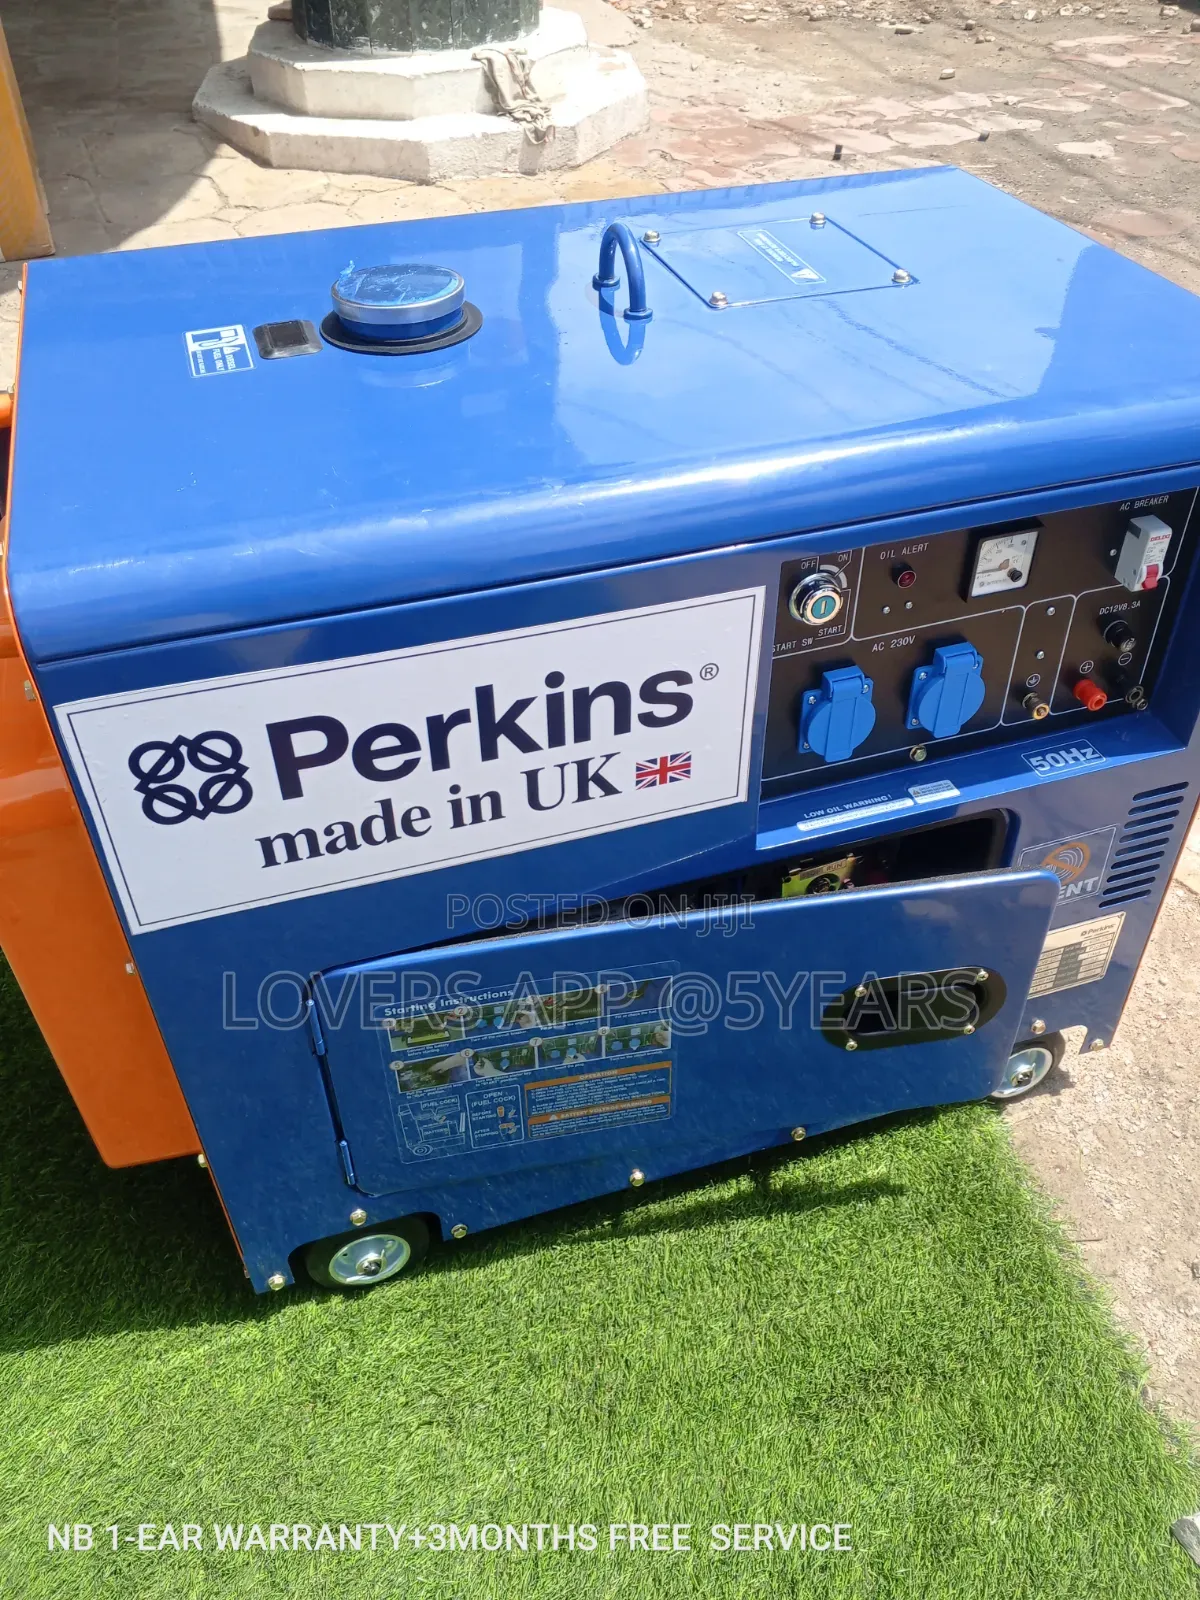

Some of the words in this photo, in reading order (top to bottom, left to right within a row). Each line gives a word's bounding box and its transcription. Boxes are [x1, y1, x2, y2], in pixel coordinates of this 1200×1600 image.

[1119, 502, 1131, 512] AC
[1133, 495, 1170, 509] BREAKER
[837, 551, 849, 562] ON
[879, 551, 896, 561] OIL
[901, 542, 930, 556] ALERT
[800, 559, 817, 570] OFF
[817, 624, 844, 637] START
[801, 637, 814, 648] SW
[871, 641, 885, 653] AC
[889, 635, 917, 649] 230V
[1028, 747, 1101, 772] 50Hz
[255, 798, 433, 869] made
[446, 784, 507, 830] in
[520, 752, 623, 812] UK
[803, 808, 826, 820] LOW
[826, 804, 844, 815] OIL
[384, 1001, 437, 1017] Starting
[440, 989, 514, 1008] Instructions
[482, 1090, 503, 1100] OPEN
